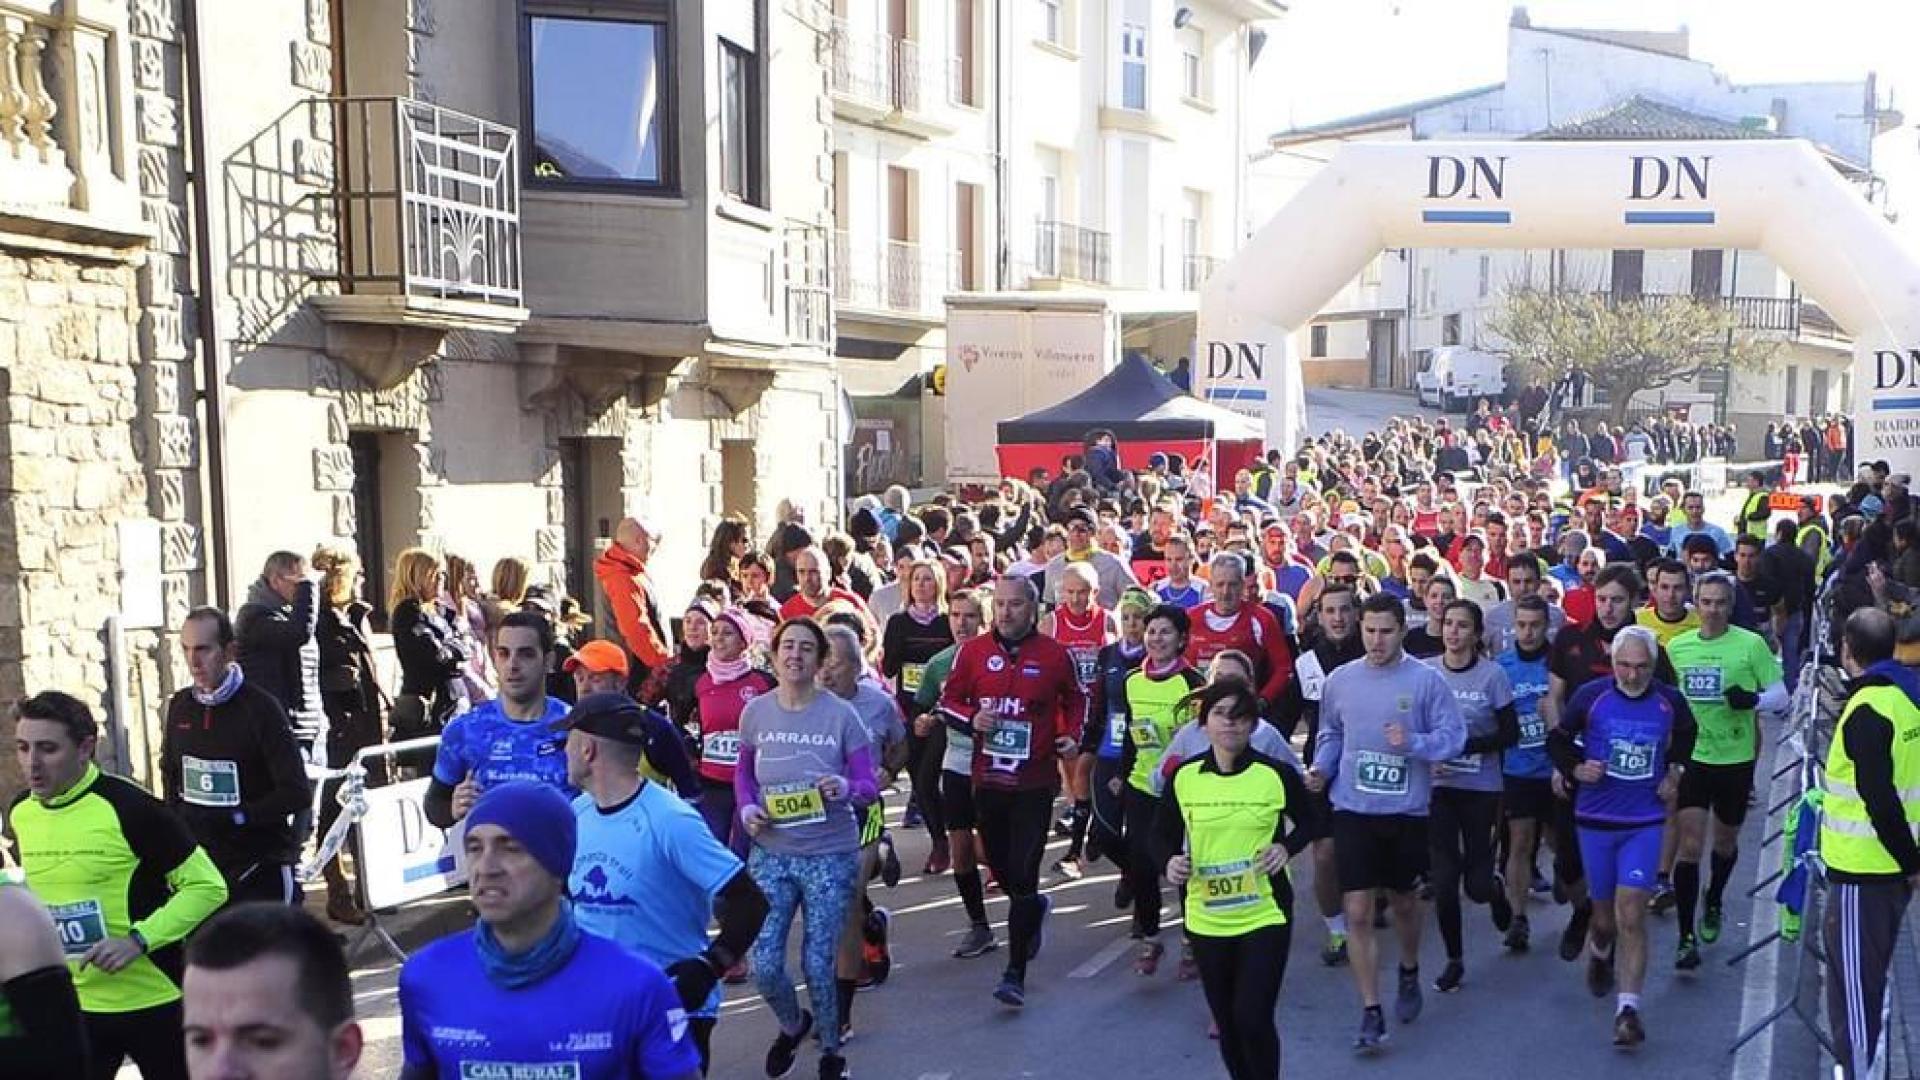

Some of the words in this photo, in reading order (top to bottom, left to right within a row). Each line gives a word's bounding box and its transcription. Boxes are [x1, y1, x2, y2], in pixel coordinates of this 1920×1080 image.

[1424, 155, 1509, 199] DN
[1627, 155, 1713, 200] DN
[1207, 341, 1267, 380] DN
[757, 731, 837, 746] LARRAGA
[993, 731, 1016, 747] 45
[201, 773, 214, 791] 6
[1365, 765, 1401, 782] 170
[775, 795, 812, 815] 504
[1207, 876, 1244, 897] 507
[57, 920, 86, 942] 10
[512, 1064, 571, 1079] RURAL
